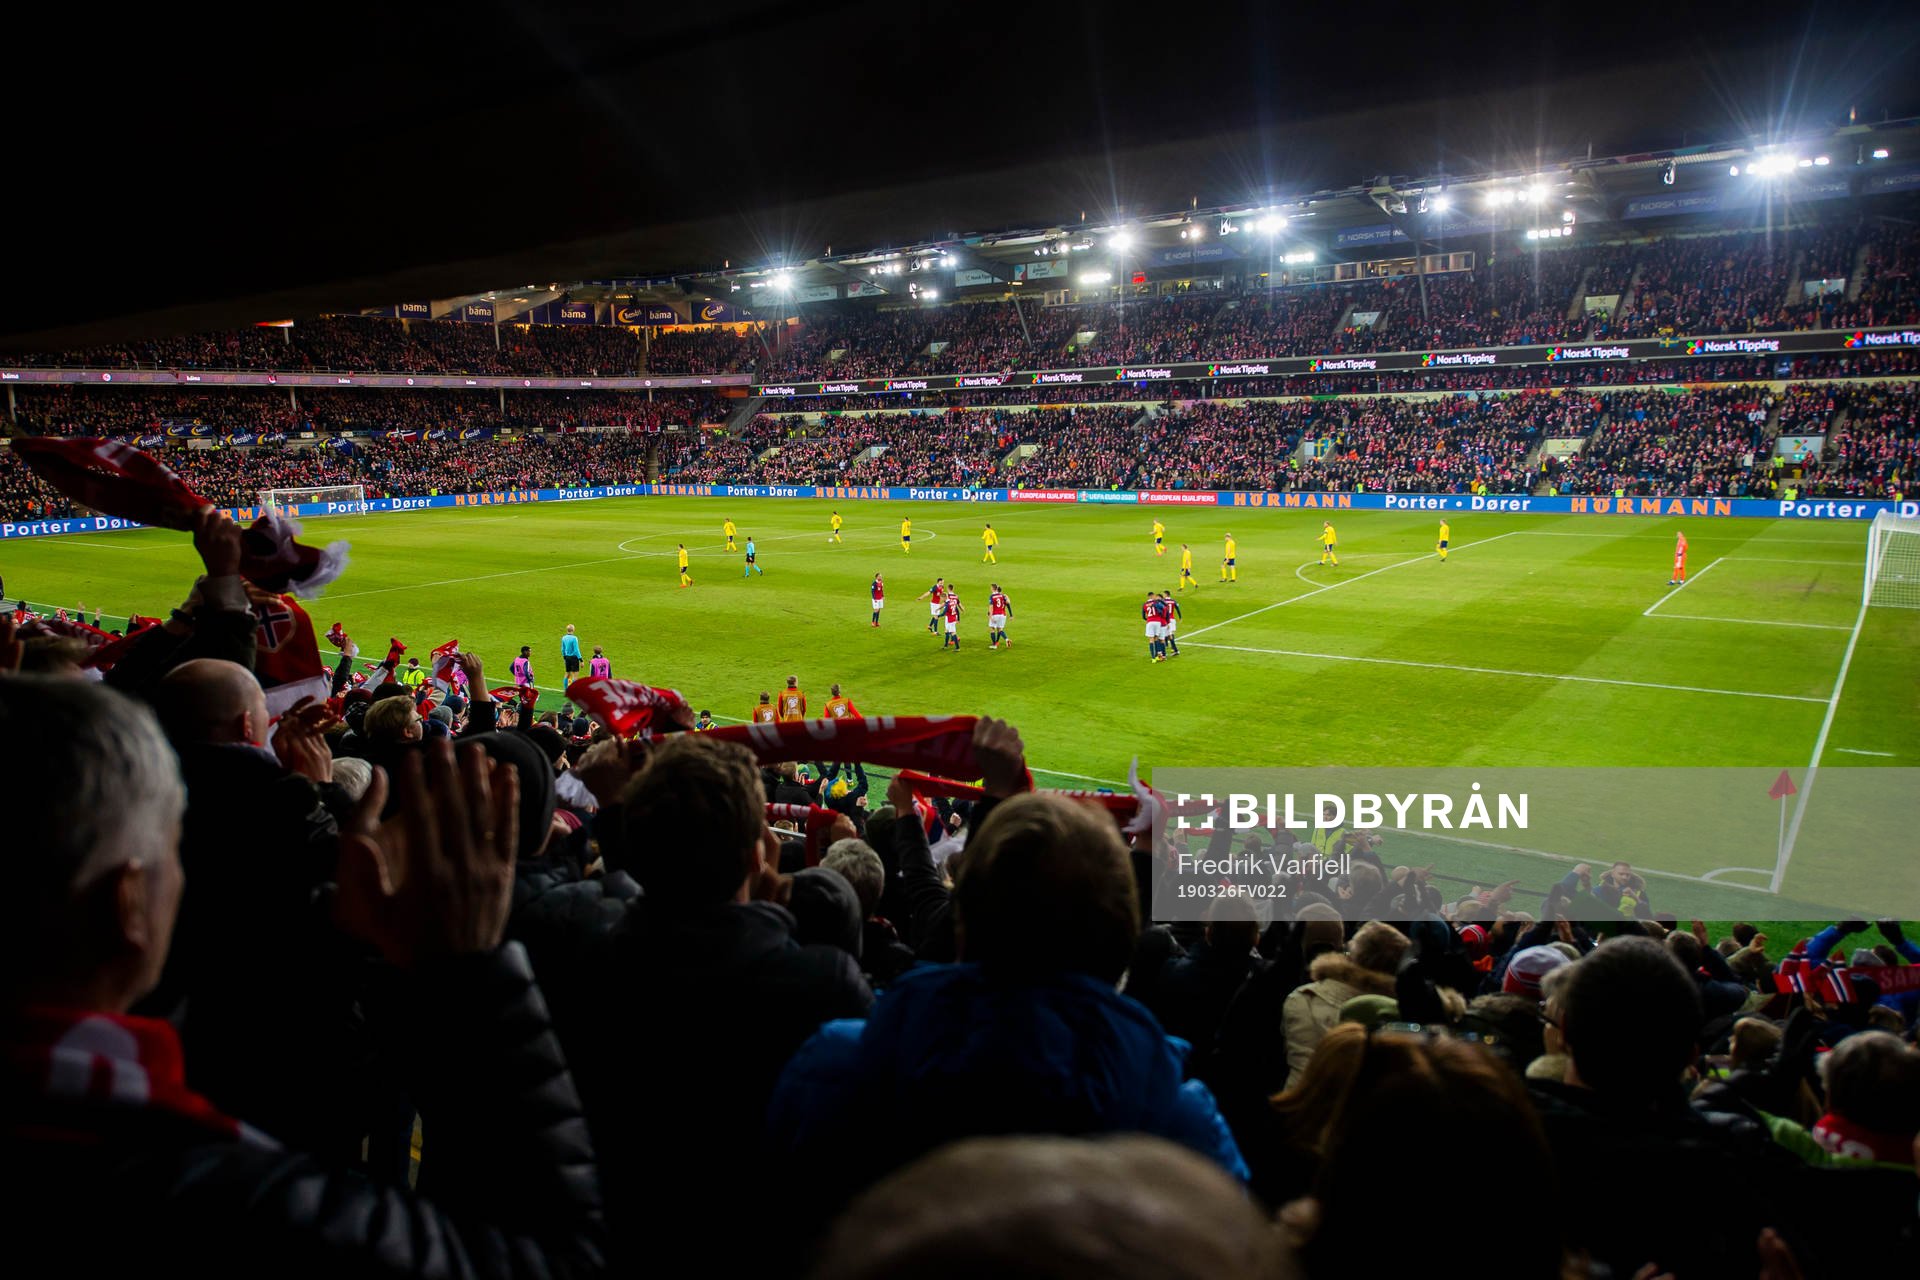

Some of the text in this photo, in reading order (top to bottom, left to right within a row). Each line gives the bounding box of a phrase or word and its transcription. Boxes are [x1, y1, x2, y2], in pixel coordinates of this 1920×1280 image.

[468, 305, 492, 317] bama
[561, 308, 587, 319] bama
[649, 309, 672, 320] bama
[1705, 338, 1780, 352] Norsk Tipping
[1865, 333, 1902, 345] Norsk
[1562, 346, 1630, 359] Norsk Tipping
[1323, 358, 1377, 370] Norsk Tipping
[1436, 353, 1496, 365] Norsk Tipping
[1126, 369, 1171, 379] Norsk Tipping
[1220, 364, 1269, 375] Norsk Tipping
[964, 377, 979, 386] Norsk
[1041, 373, 1083, 383] Norsk Tipping
[765, 386, 795, 396] Norsk Tipping
[826, 384, 859, 393] Norsk Tipping
[892, 381, 928, 391] Norsk Tipping
[140, 435, 163, 448] Bendit
[232, 433, 253, 445] Bendit
[559, 486, 636, 499] Porter Dører
[652, 484, 712, 497] HÖRMANN
[728, 486, 798, 498] Porter Dører
[816, 487, 890, 499] HÖRMANN
[910, 488, 948, 500] Porter
[1019, 491, 1076, 501] EUROPEAN QUALIFIERS
[455, 490, 539, 505] HÖRMANN
[1089, 493, 1137, 502] UEFA EURO 2020
[1150, 494, 1216, 503] EUROPEAN QUALIFIERS
[1233, 491, 1351, 507] HÖRMANN
[1385, 494, 1531, 511] Porter Dører
[328, 496, 432, 514] Porter Dører
[1570, 497, 1731, 516] HÖRMANN
[1779, 499, 1867, 518] Porter
[2, 520, 72, 537] Porter
[996, 598, 1002, 608] 3
[1146, 606, 1156, 617] 21
